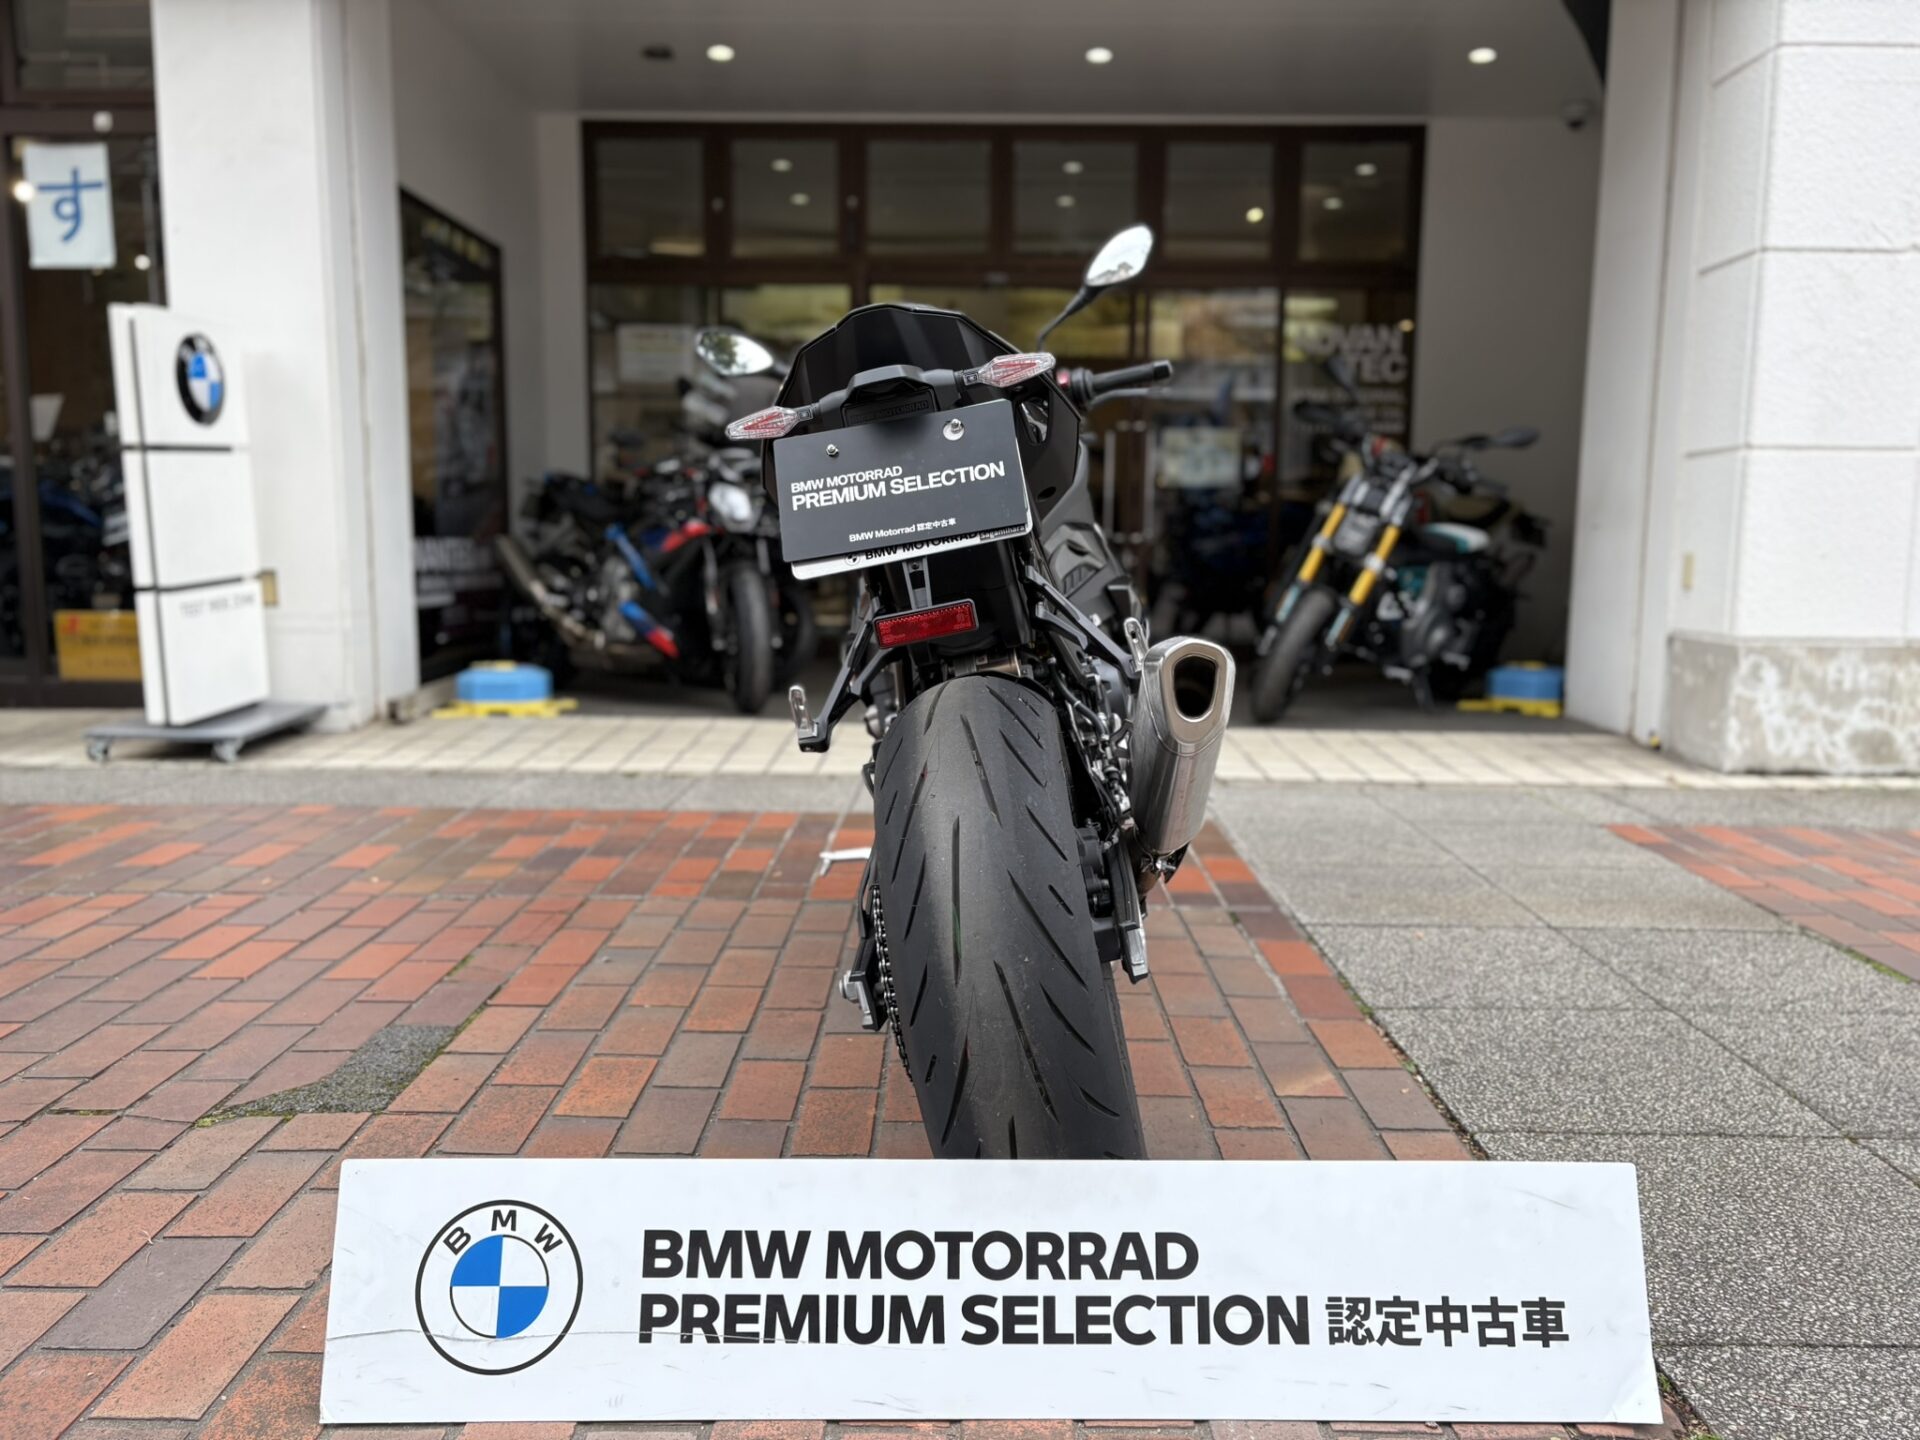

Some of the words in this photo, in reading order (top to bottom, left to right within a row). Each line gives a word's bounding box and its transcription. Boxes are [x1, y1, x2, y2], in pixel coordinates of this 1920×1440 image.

[37, 166, 103, 242] す
[790, 478, 824, 494] BMW
[826, 465, 903, 488] MOTORRAD
[791, 481, 887, 511] PREMIUM
[890, 461, 1005, 495] SELECTION
[849, 532, 874, 542] BMW
[875, 524, 915, 539] Motorrad
[865, 544, 898, 560] BMW
[980, 525, 1026, 540] Sagamihara
[443, 1209, 563, 1256] BMW
[642, 1229, 812, 1279] BMW
[825, 1229, 1199, 1281] MOTORRAD
[639, 1294, 945, 1345] PREMIUM
[962, 1294, 1310, 1346] SELECTION
[1325, 1295, 1569, 1348] 認定中古車
